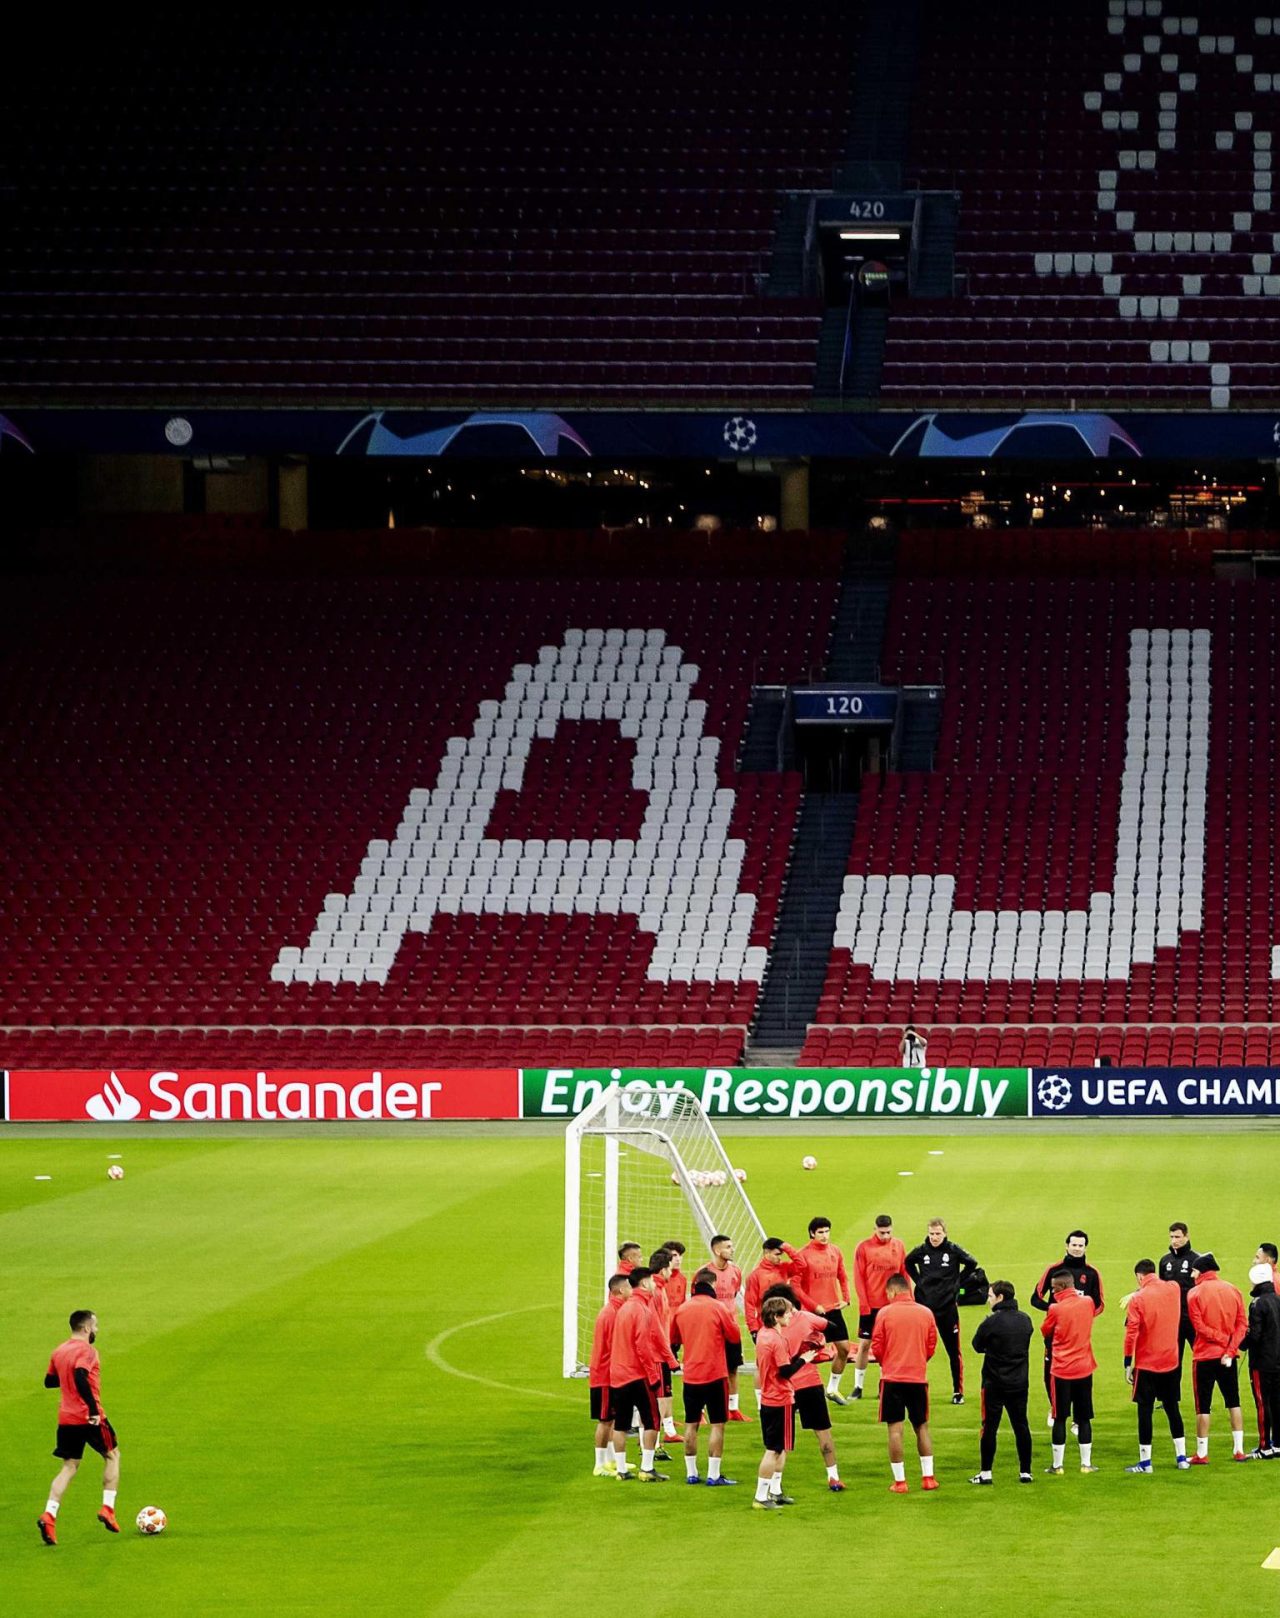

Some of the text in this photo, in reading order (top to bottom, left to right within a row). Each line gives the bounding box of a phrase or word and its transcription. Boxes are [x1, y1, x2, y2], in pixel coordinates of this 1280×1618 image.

[849, 201, 885, 218] 420
[826, 696, 863, 714] 120
[149, 1071, 442, 1120] Santander
[701, 1068, 1009, 1118] Responsibly
[1081, 1079, 1168, 1105] UEFA
